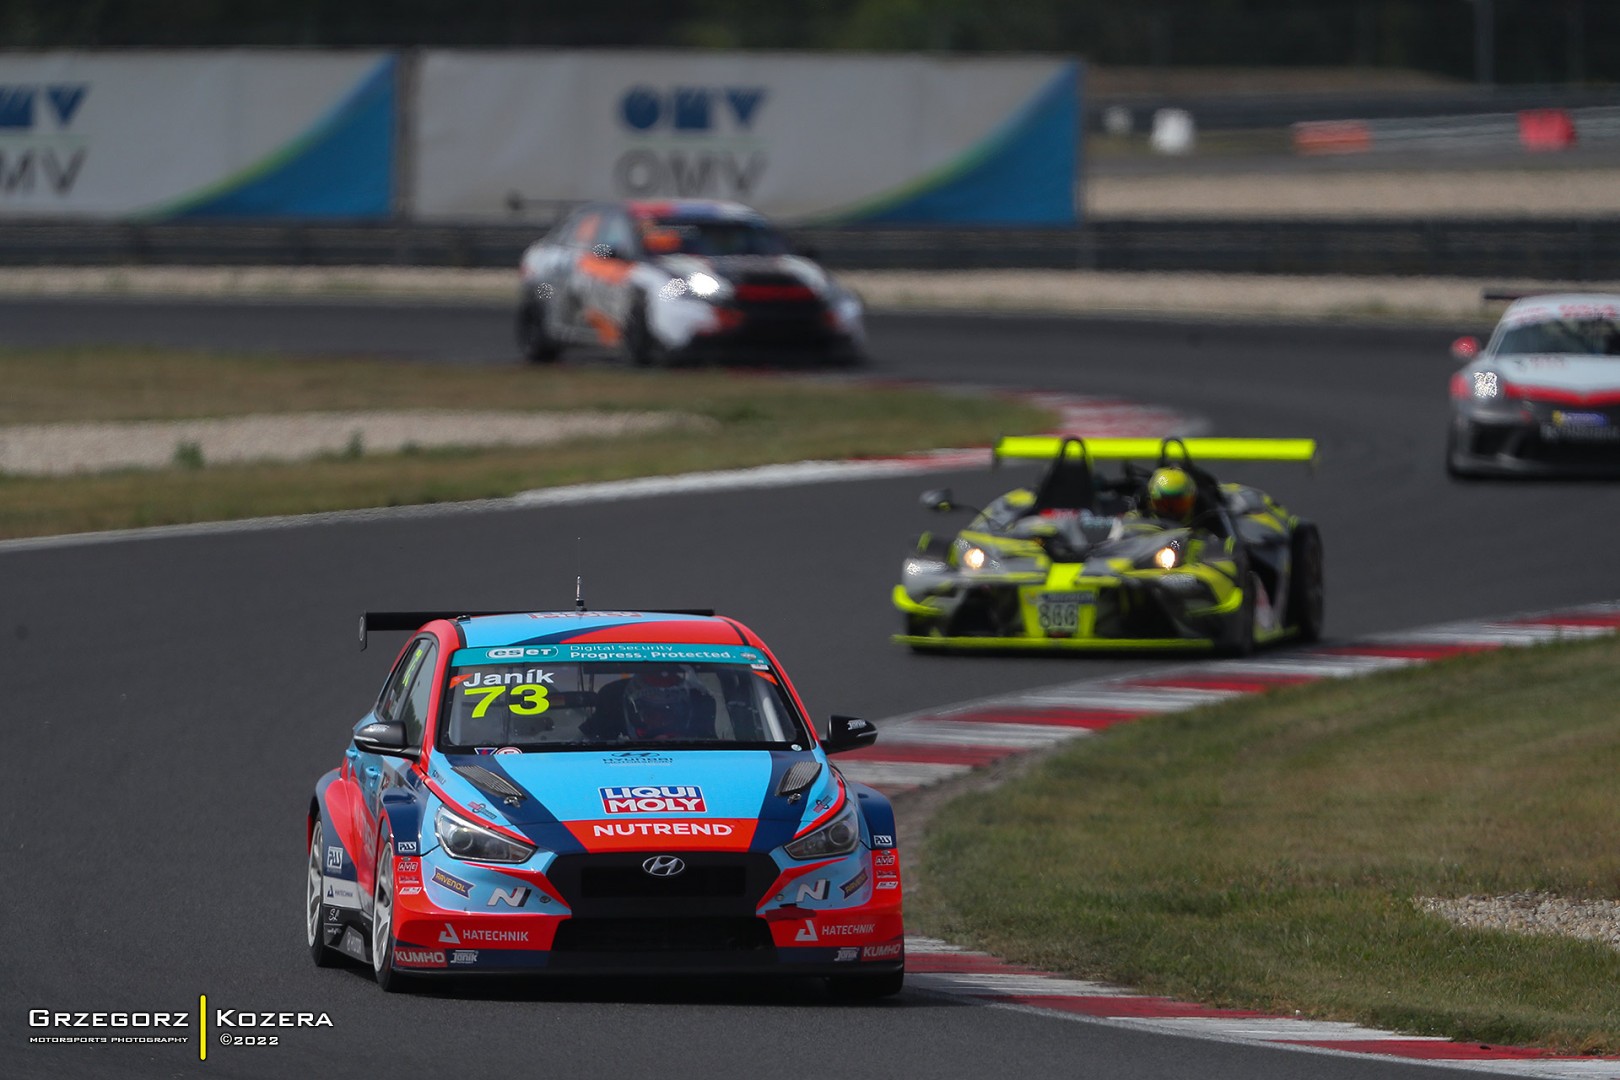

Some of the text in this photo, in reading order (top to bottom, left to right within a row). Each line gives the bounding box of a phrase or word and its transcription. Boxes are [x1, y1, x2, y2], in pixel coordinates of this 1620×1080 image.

[620, 84, 768, 130] OMV
[614, 150, 769, 198] OMV
[570, 652, 647, 660] Progress.
[651, 651, 737, 659] Protected.
[463, 669, 554, 687] Janík
[464, 684, 550, 719] 73
[605, 786, 698, 799] LIQUI
[609, 798, 702, 812] MOLY
[593, 823, 733, 837] NUTREND
[435, 872, 467, 893] RAVENOL
[462, 929, 529, 942] HATECHNIK
[822, 924, 875, 935] HATECHNIK
[395, 950, 445, 963] KUMHO
[863, 944, 901, 957] KUMHO
